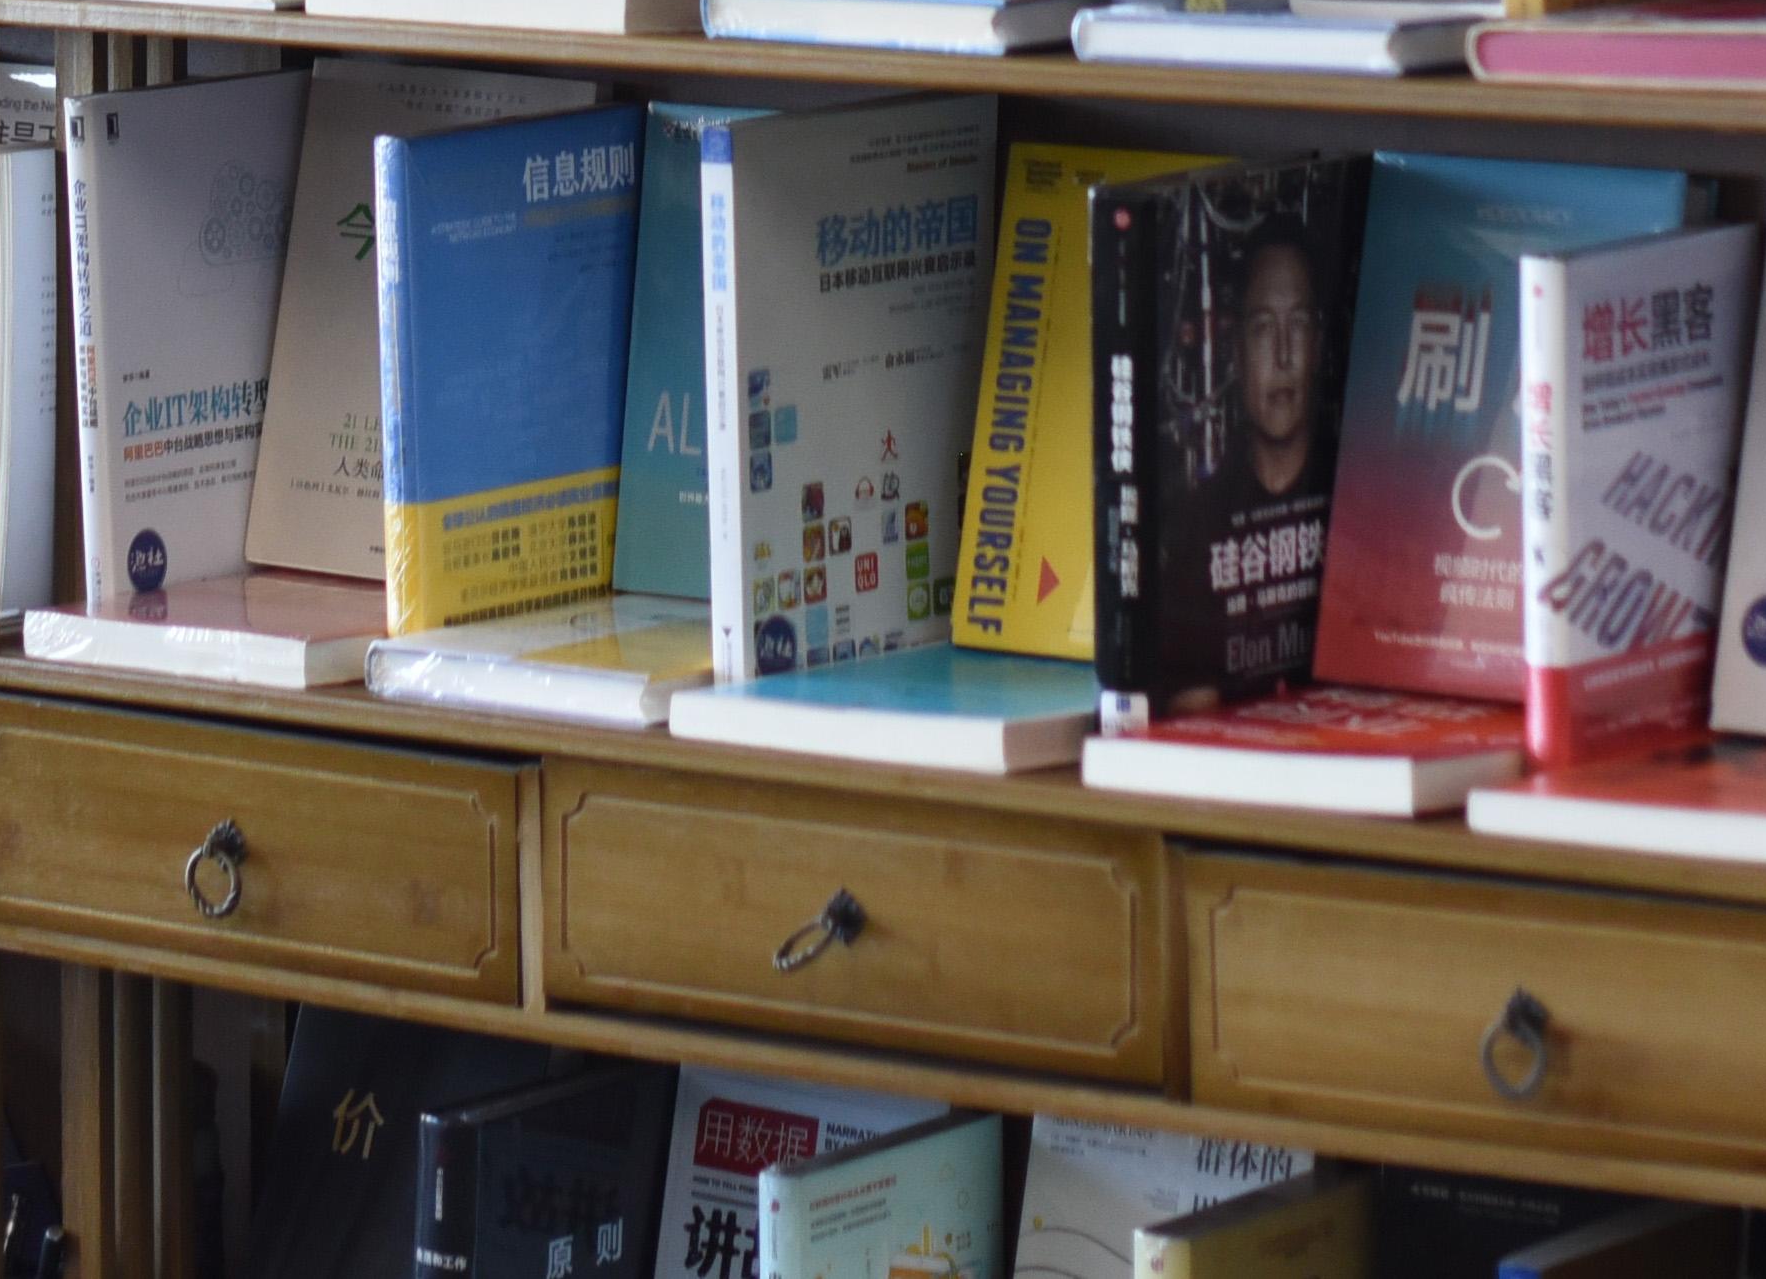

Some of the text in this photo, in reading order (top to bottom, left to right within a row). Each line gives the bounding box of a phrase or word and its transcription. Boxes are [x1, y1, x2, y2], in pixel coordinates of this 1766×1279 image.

[522, 141, 636, 204] 信息规则
[816, 193, 979, 270] 移动的帝国
[818, 251, 977, 295] 日本移动互联网兴衰启示录
[1399, 284, 1492, 416] 刷
[1582, 282, 1715, 363] 增长黑客
[966, 218, 1053, 636] ON MANAGING YOURSELF
[856, 555, 878, 574] UNI
[857, 573, 878, 591] QLO
[1209, 519, 1324, 592] 硅谷钢铁
[1226, 625, 1275, 676] Elon
[332, 1088, 385, 1160] 价
[698, 1108, 808, 1167] 用数据
[546, 1217, 624, 1279] 原则
